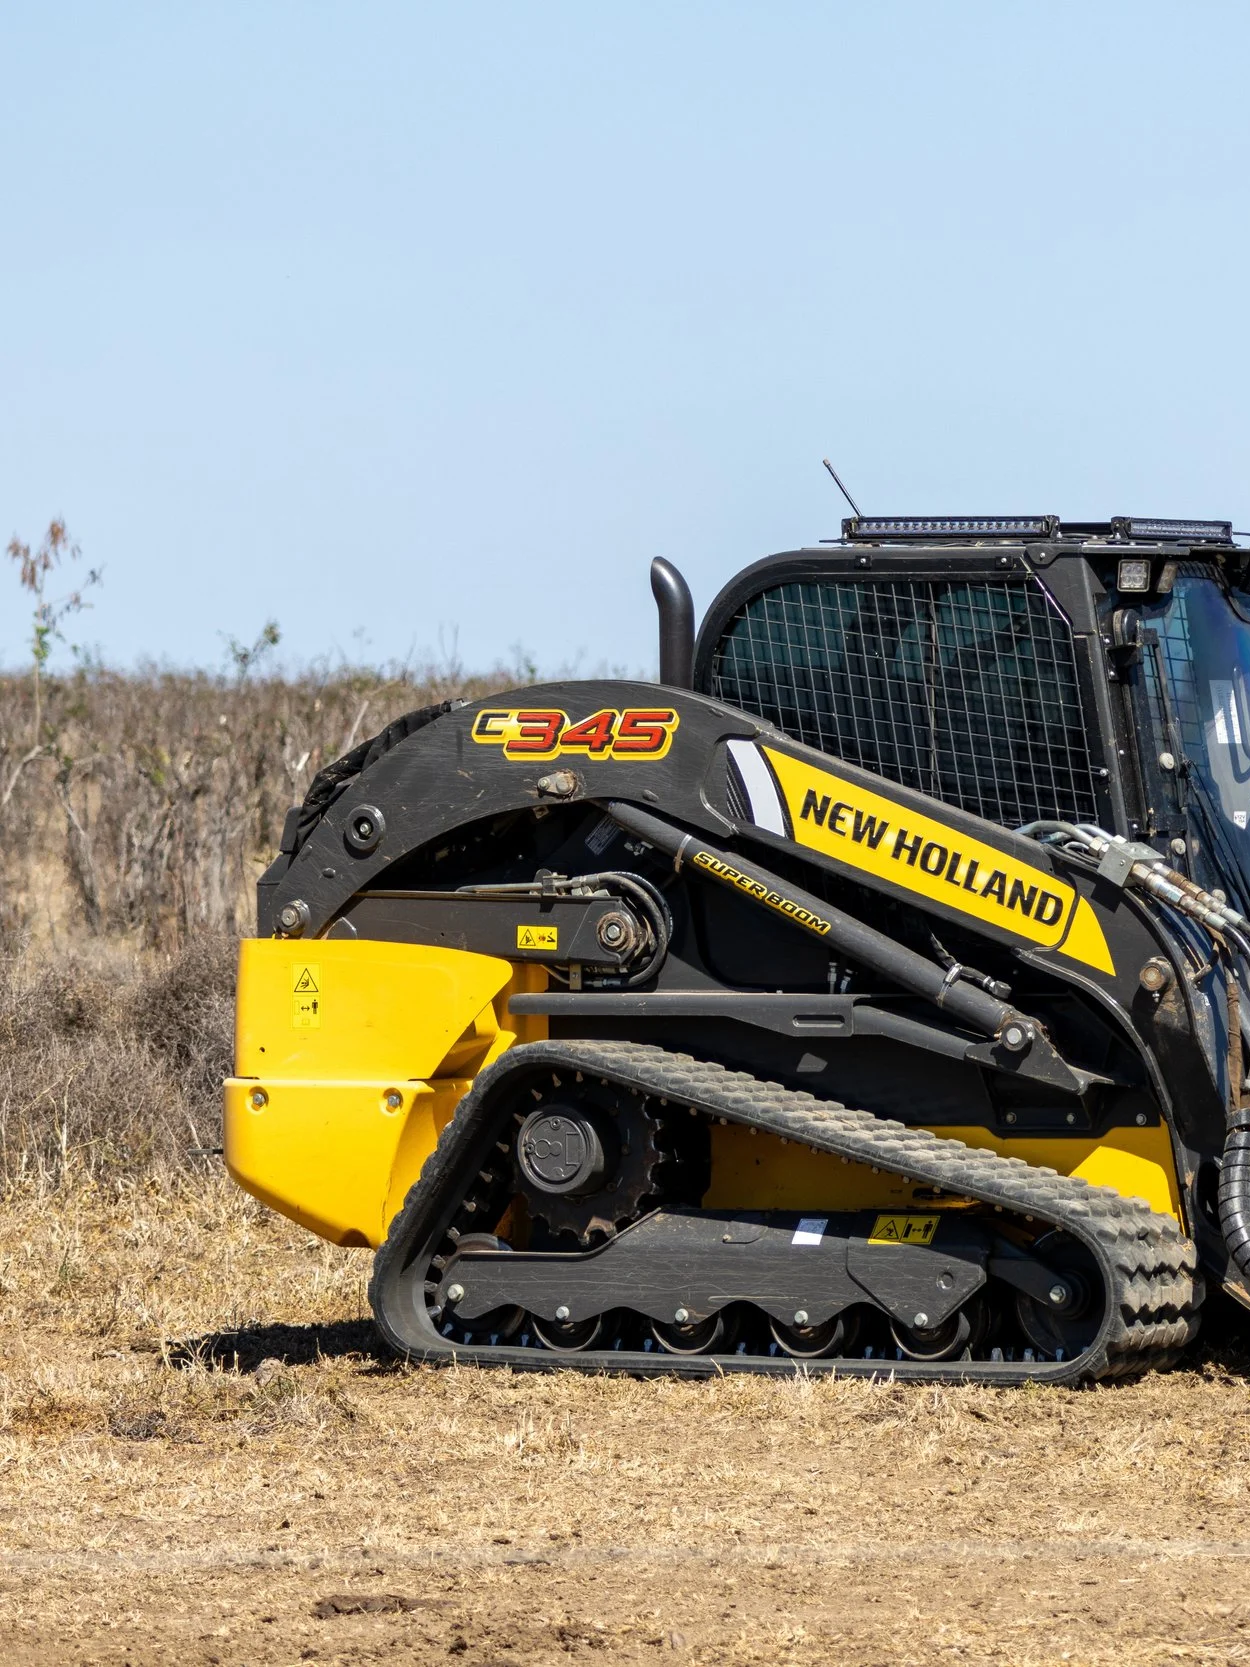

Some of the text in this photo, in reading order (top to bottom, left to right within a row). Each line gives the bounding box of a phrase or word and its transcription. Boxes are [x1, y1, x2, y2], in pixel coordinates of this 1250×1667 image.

[473, 710, 677, 757] C345
[696, 851, 830, 934] SUPER BOOM
[799, 788, 1064, 927] NEW HOLLAND
